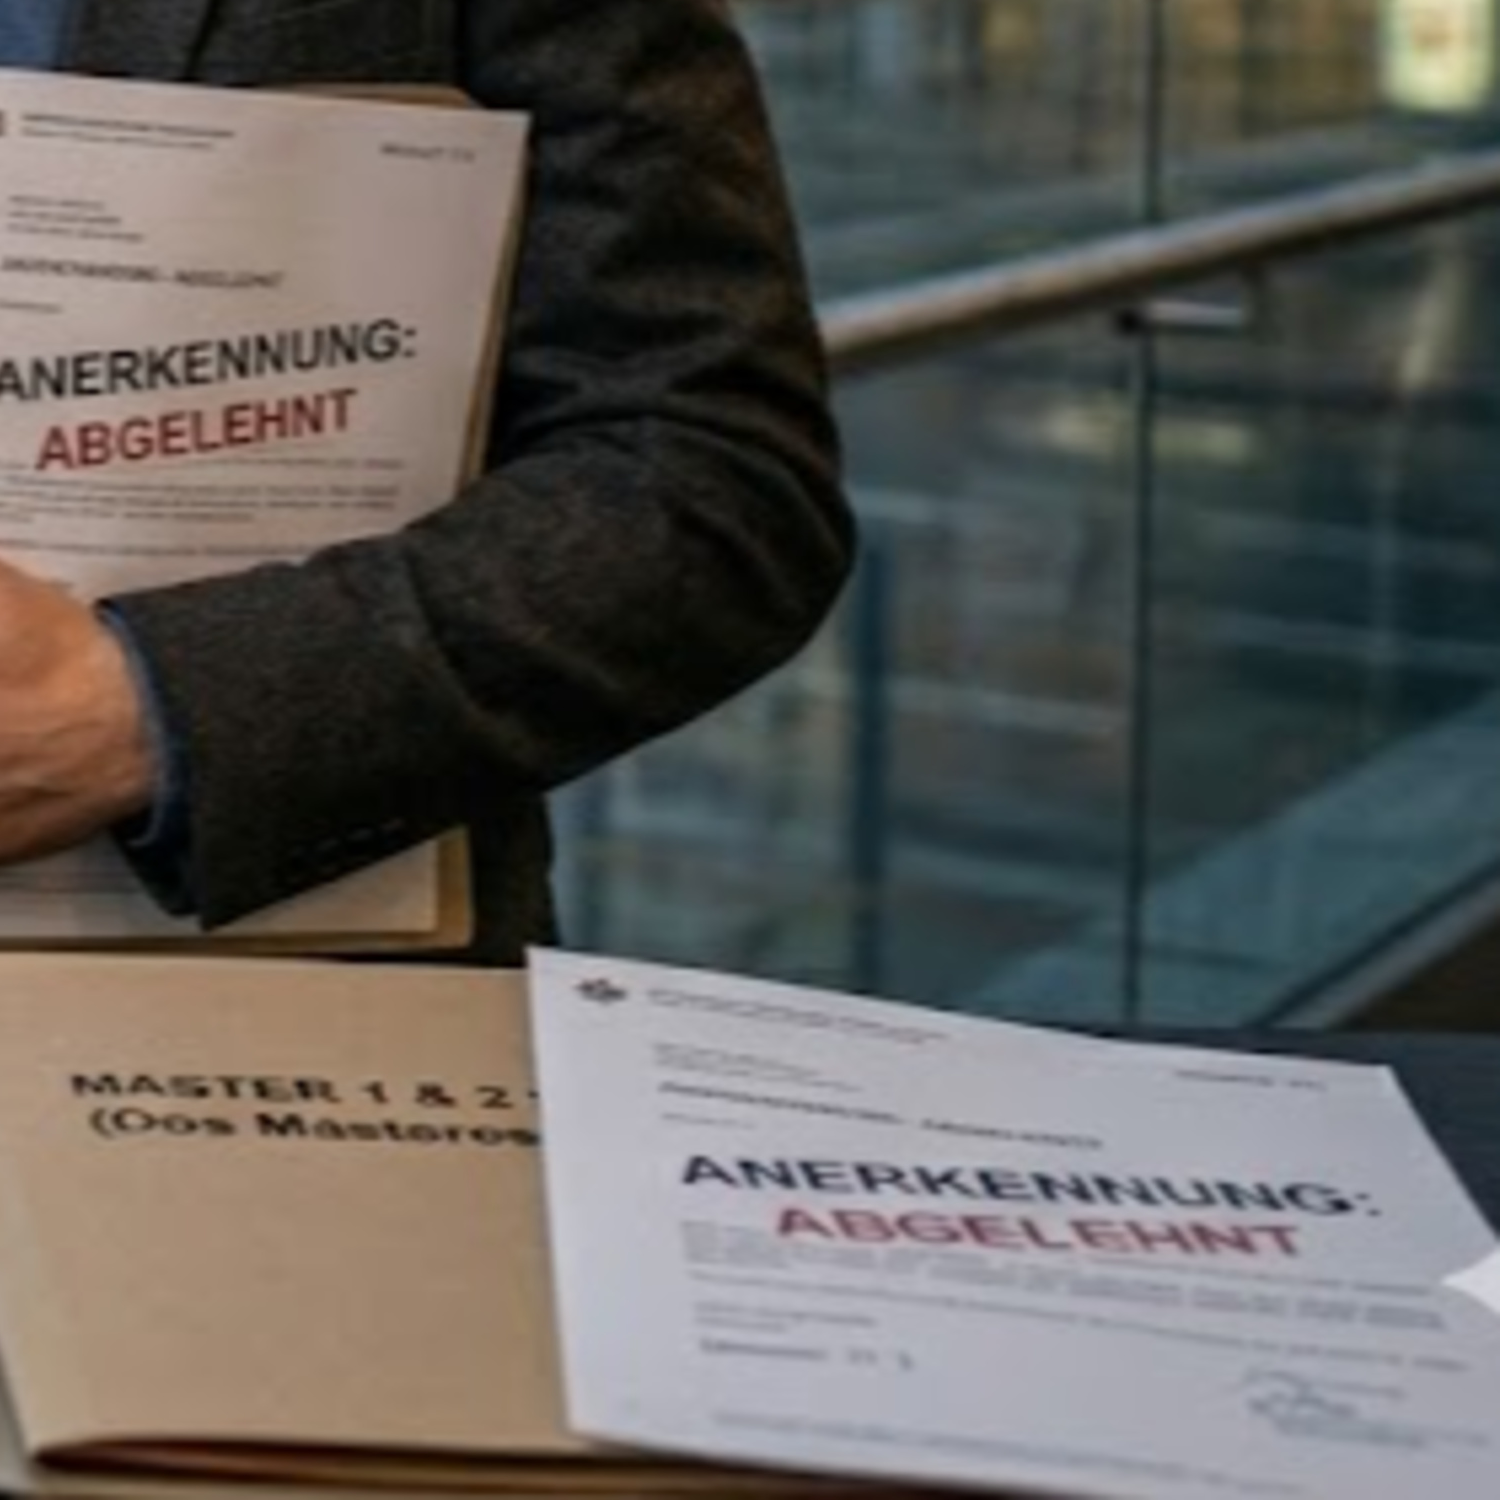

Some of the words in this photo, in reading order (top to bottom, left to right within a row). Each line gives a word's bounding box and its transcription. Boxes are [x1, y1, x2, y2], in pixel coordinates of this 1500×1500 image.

[34, 387, 358, 472] ABGELEHNT
[70, 1073, 341, 1104] MASTER
[362, 1080, 391, 1106] 1
[414, 1083, 457, 1109] &
[475, 1085, 514, 1110] 2
[680, 1153, 1382, 1217] ANERKENNUNG:
[775, 1207, 1301, 1257] ABGELEHNT
